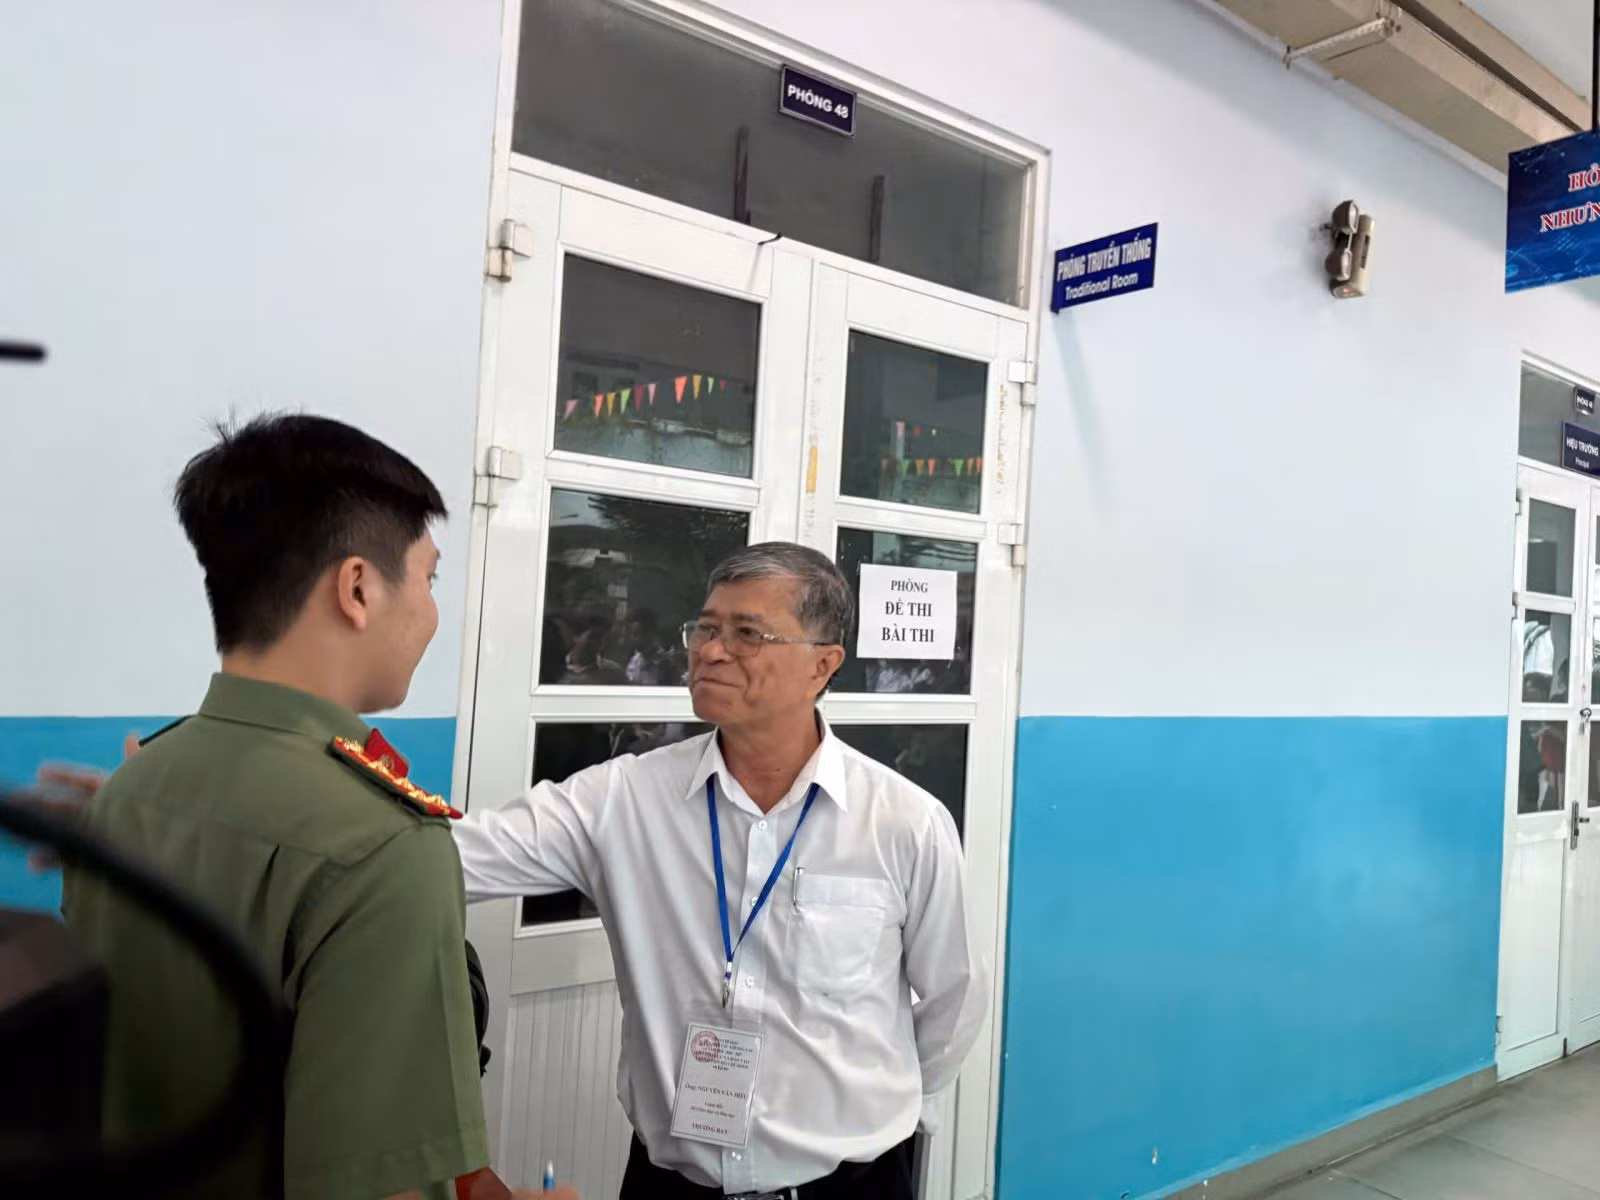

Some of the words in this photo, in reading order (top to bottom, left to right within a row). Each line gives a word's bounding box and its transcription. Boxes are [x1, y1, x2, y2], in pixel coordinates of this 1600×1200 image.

[787, 84, 833, 112] PHÒNG
[834, 104, 849, 119] 48
[1057, 253, 1086, 282] PHÒNG
[1065, 276, 1111, 300] Traditional
[1111, 272, 1138, 290] Room
[890, 578, 928, 593] PHÒNG
[885, 596, 904, 616] ĐỀ
[907, 602, 932, 617] THI
[881, 623, 906, 642] BÀI
[910, 628, 935, 643] THI
